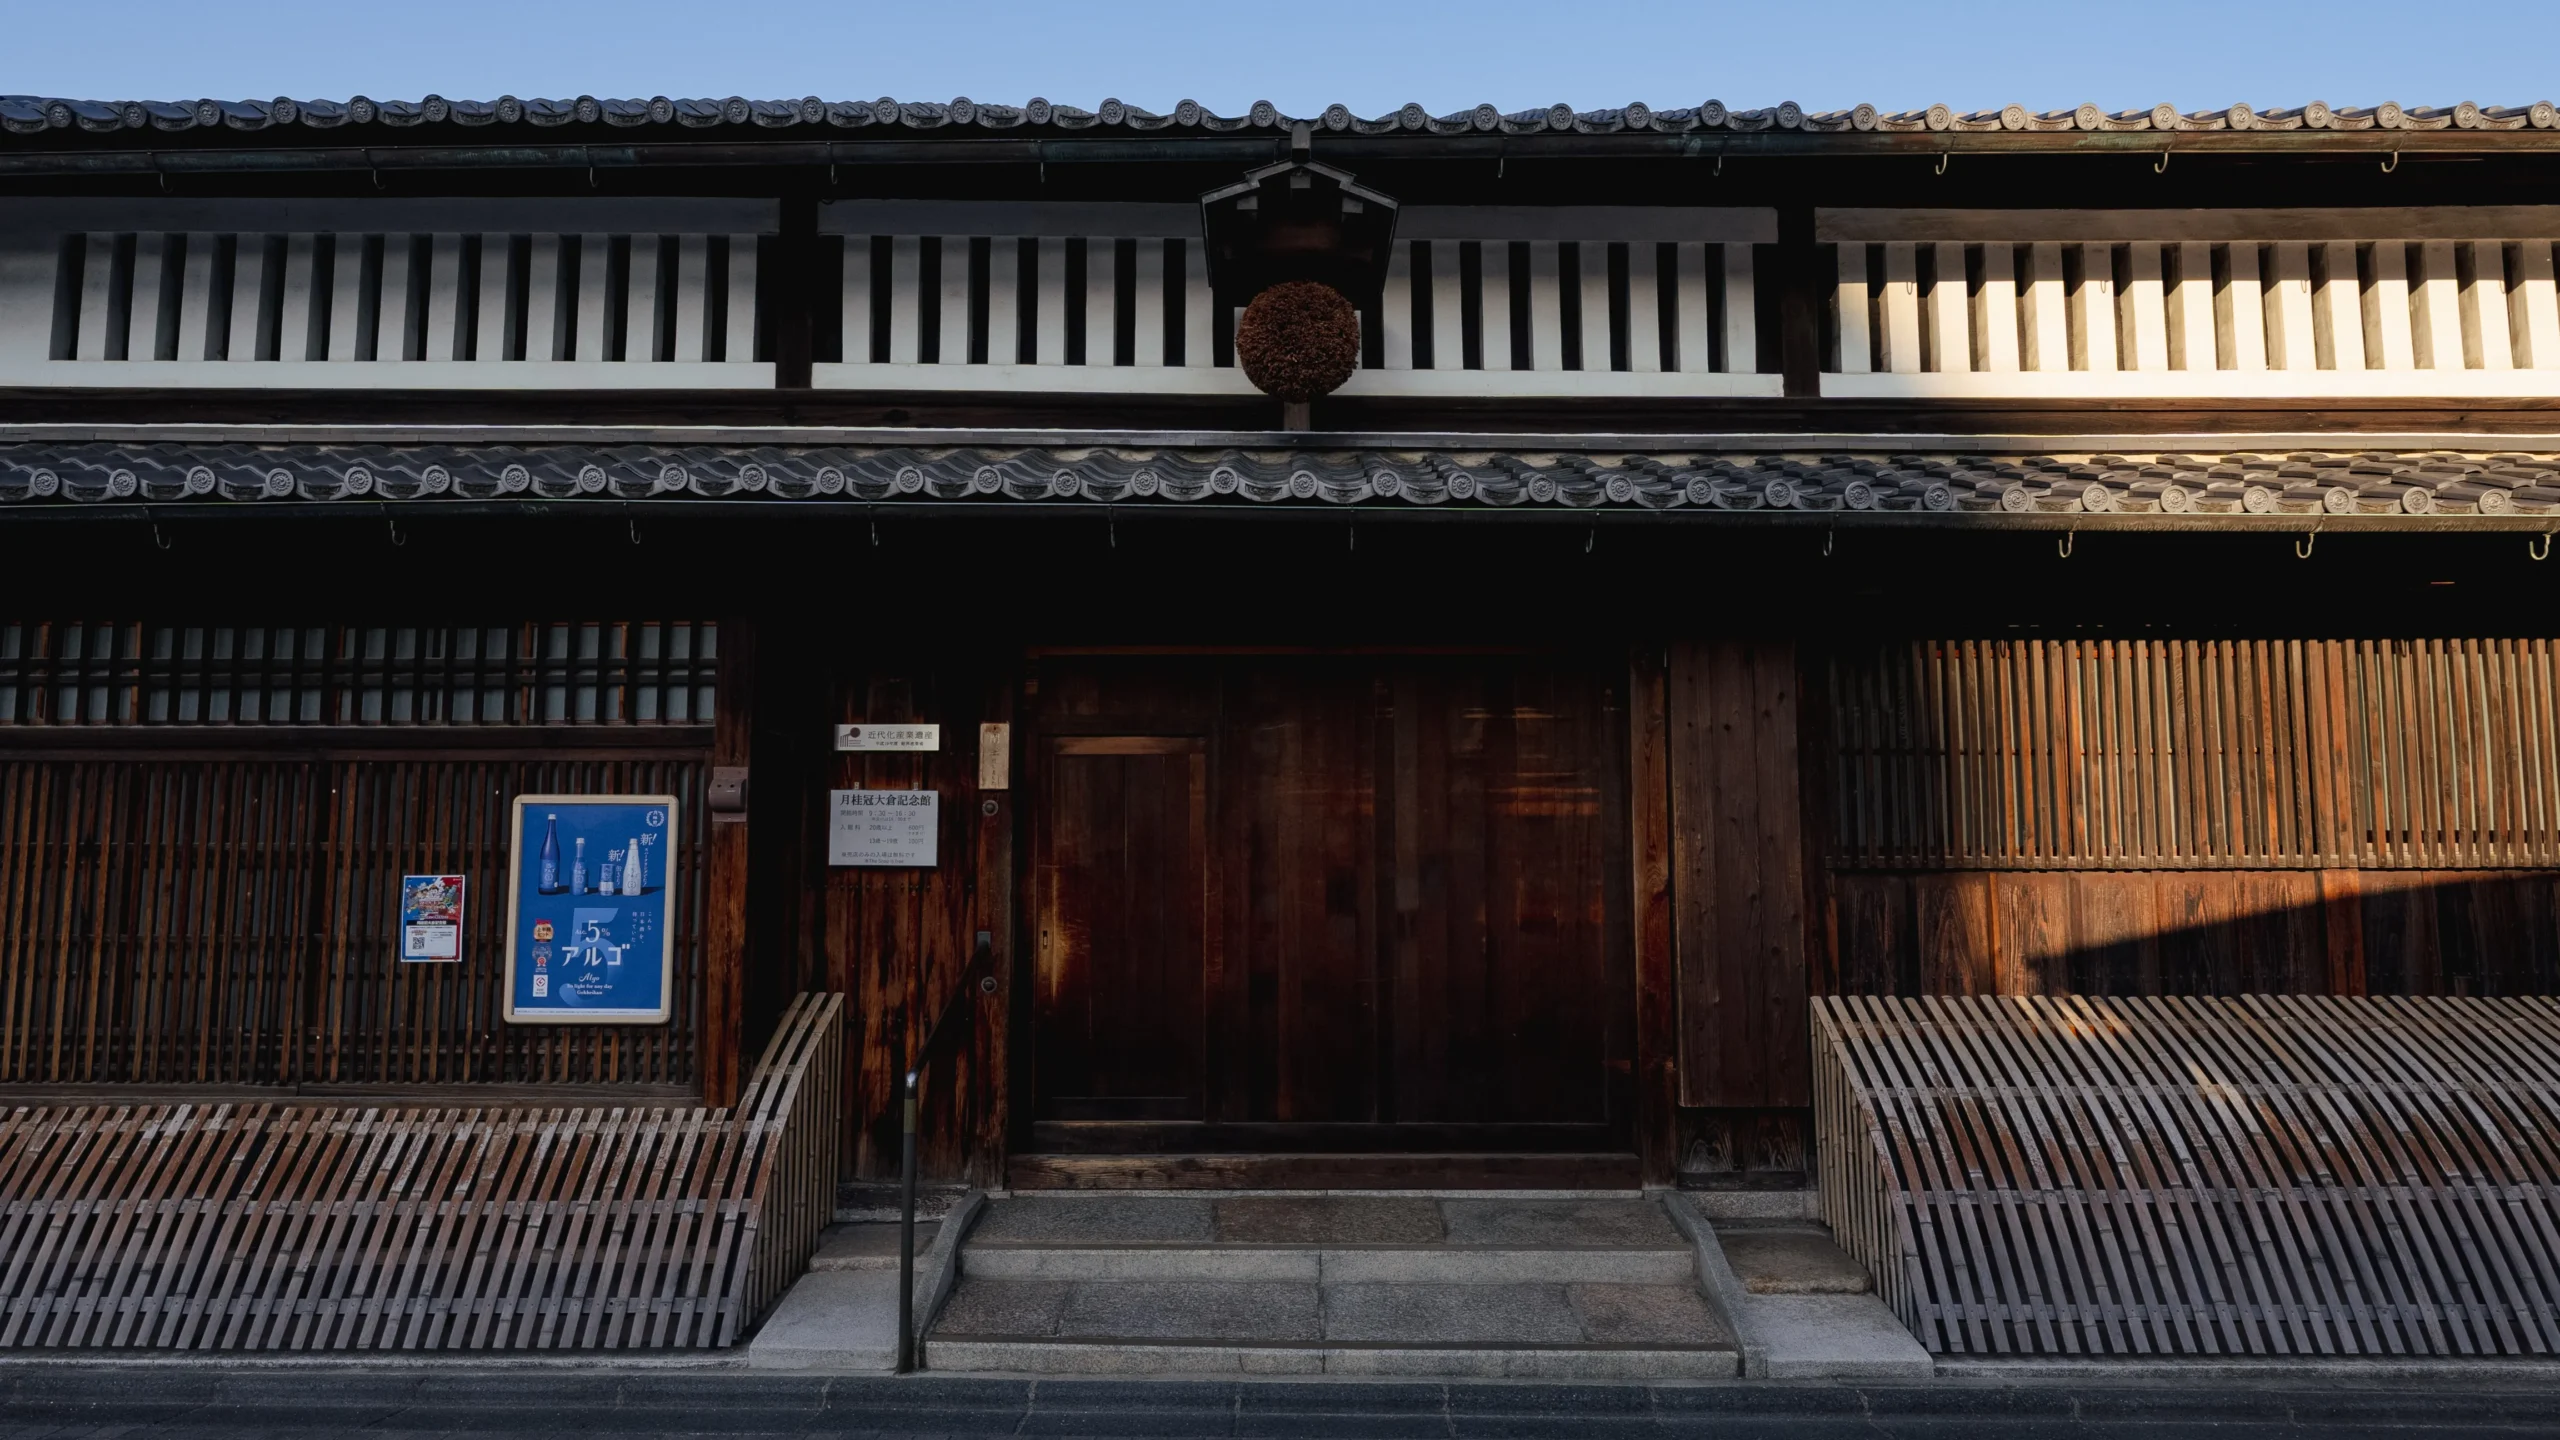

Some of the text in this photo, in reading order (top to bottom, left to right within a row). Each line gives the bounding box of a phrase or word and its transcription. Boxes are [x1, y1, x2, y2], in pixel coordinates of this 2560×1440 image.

[868, 731, 933, 740] 近代化産業遺産
[840, 794, 931, 806] 月桂冠大倉記念館
[586, 920, 600, 942] 5
[602, 928, 610, 937] %
[562, 944, 630, 967] アルゴ
[578, 972, 600, 983] Algo
